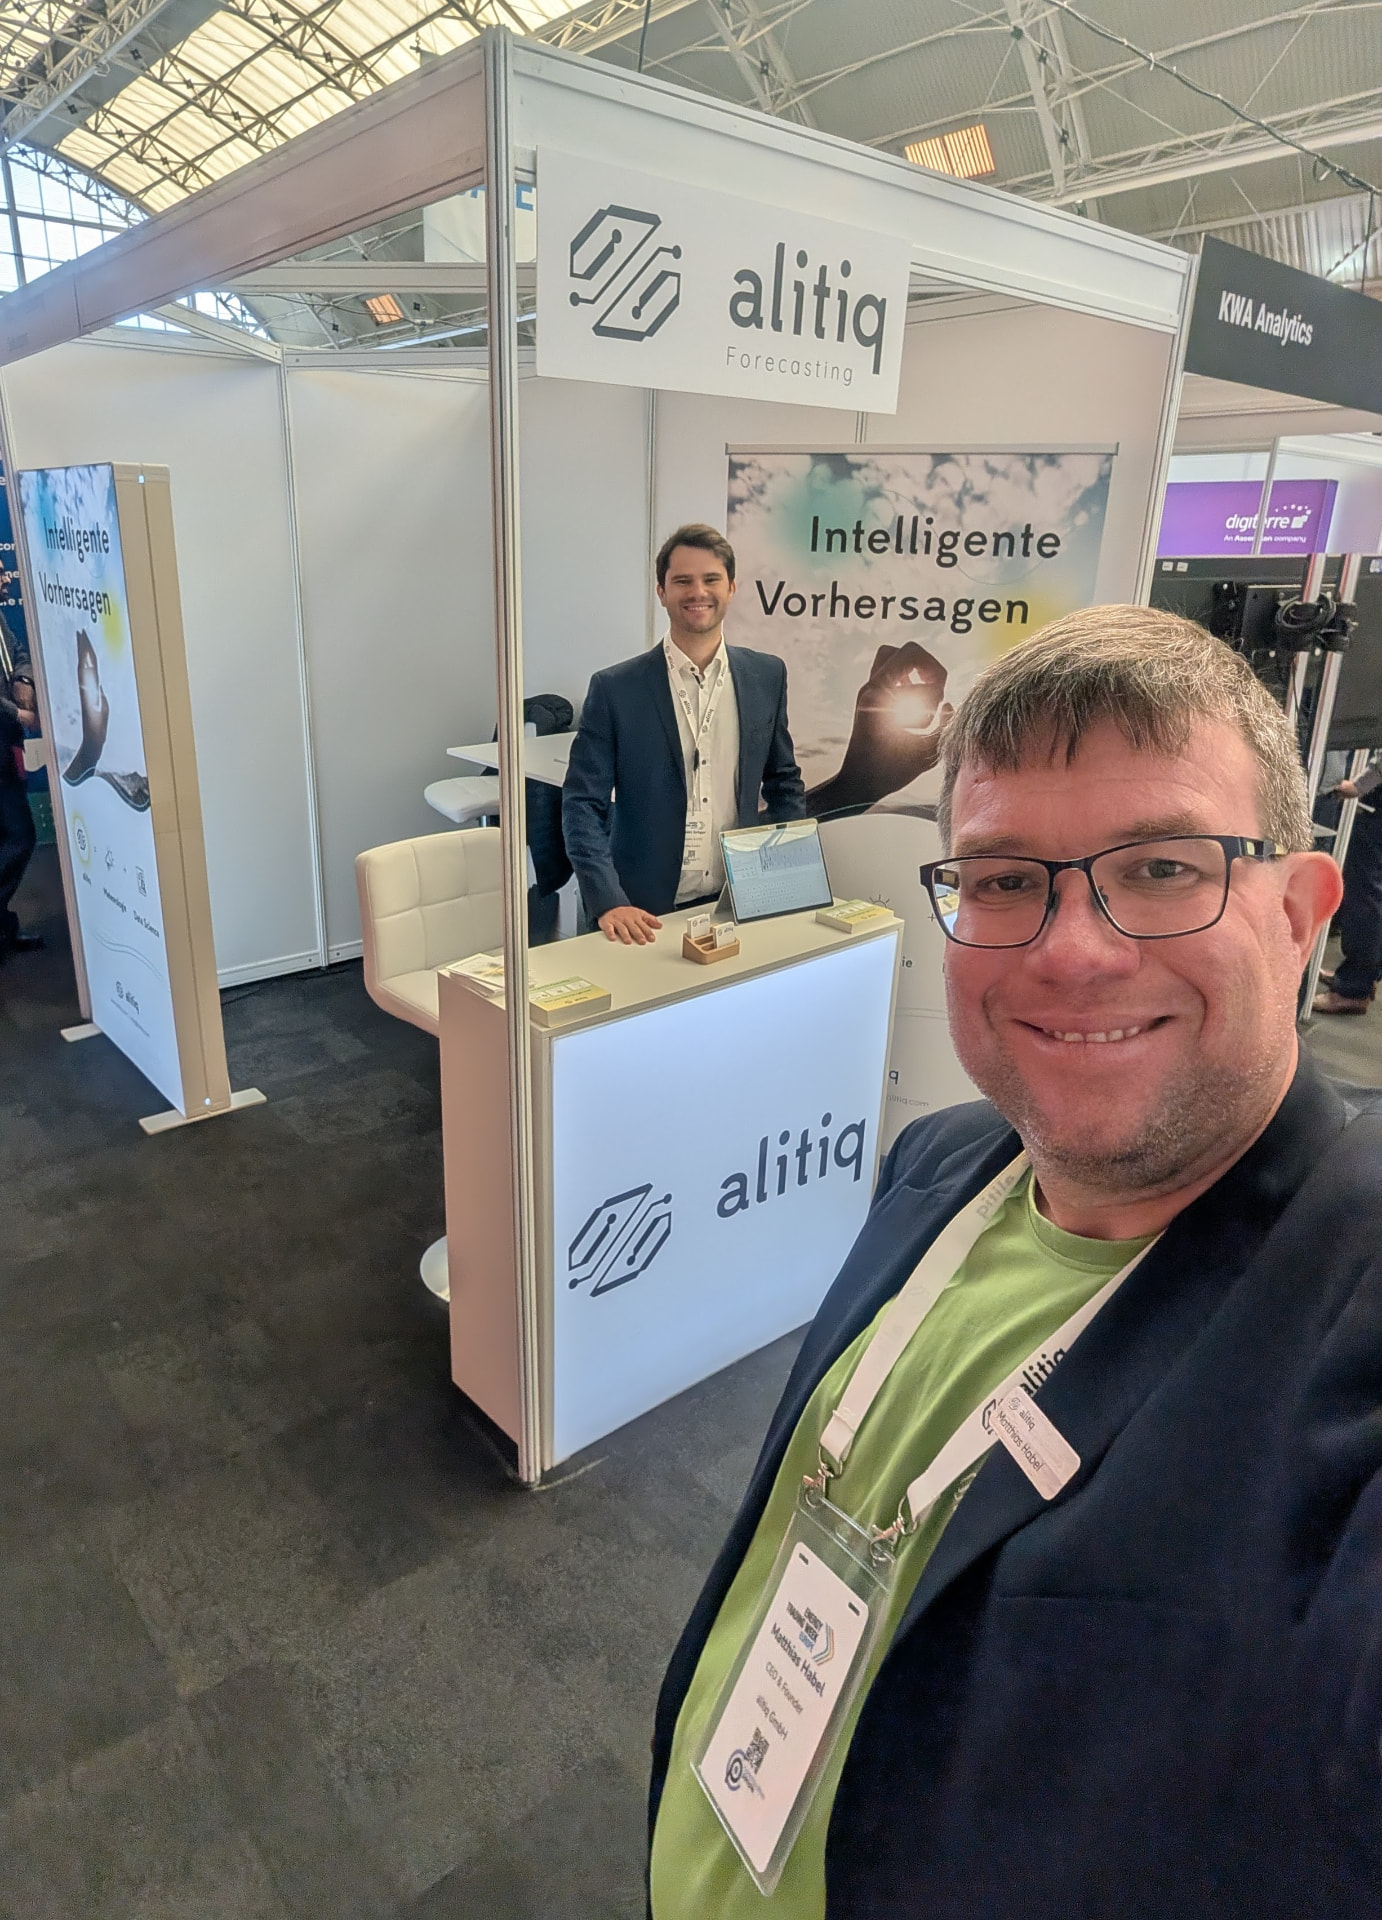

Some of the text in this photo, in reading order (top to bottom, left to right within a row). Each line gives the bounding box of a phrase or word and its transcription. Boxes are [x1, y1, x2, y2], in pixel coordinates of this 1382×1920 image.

[728, 242, 887, 375] alitiq
[1218, 290, 1314, 348] KWA Analytics
[726, 345, 854, 387] Forecasting
[43, 517, 110, 563] Intelligente
[809, 515, 1061, 567] Intelligente
[1225, 513, 1290, 532] digitrre
[39, 571, 112, 624] Vorhersagen
[755, 580, 1030, 633] Vorhersagen
[716, 1111, 866, 1218] alitiq
[997, 1410, 1043, 1473] Matthias Habel
[1018, 1409, 1036, 1432] alitiq
[786, 1601, 818, 1643] TRADING WEEK
[803, 1606, 824, 1629] ENERGY
[770, 1622, 825, 1698] Matthias Habel
[765, 1661, 779, 1681] CEO
[780, 1681, 804, 1715] Founder
[769, 1710, 789, 1741] GmbH
